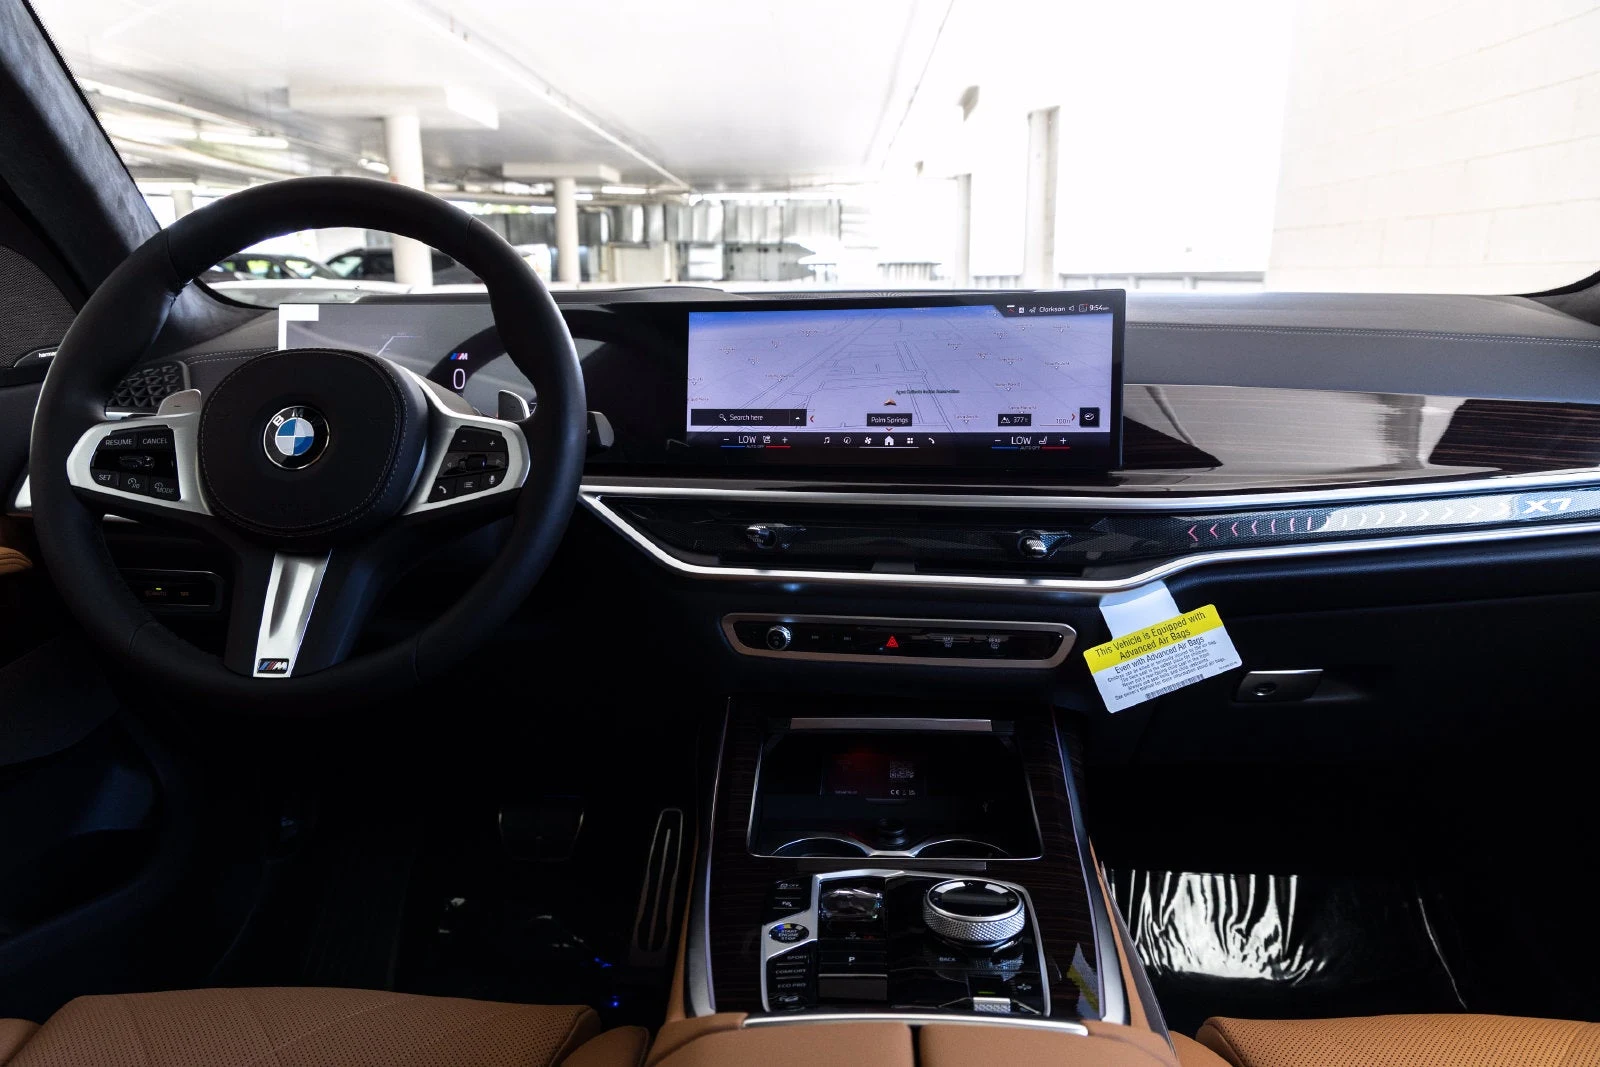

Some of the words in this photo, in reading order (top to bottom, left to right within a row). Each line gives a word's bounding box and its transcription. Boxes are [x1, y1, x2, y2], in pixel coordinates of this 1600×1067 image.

[1039, 305, 1066, 313] Clarkson
[453, 368, 466, 390] 0
[729, 413, 750, 421] Search
[750, 413, 764, 421] here
[886, 416, 909, 425] Springs
[105, 438, 133, 446] RESUME
[142, 437, 168, 445] CANCEL
[738, 435, 757, 444] LOW
[1011, 436, 1032, 445] LOW
[156, 487, 174, 495] MODE
[1521, 497, 1572, 514] X7
[1095, 644, 1113, 657] This
[1113, 635, 1142, 650] Vehicle
[1142, 631, 1151, 640] is
[1151, 617, 1187, 637] Equipped
[1188, 611, 1206, 623] with
[1119, 641, 1157, 660] Advanced
[1158, 635, 1169, 645] Air
[1170, 628, 1191, 641] Bags
[1115, 662, 1131, 674] Even
[1131, 657, 1146, 668] with
[1146, 646, 1177, 663] Advanced
[1177, 641, 1187, 651] Air
[1187, 637, 1205, 647] Bags
